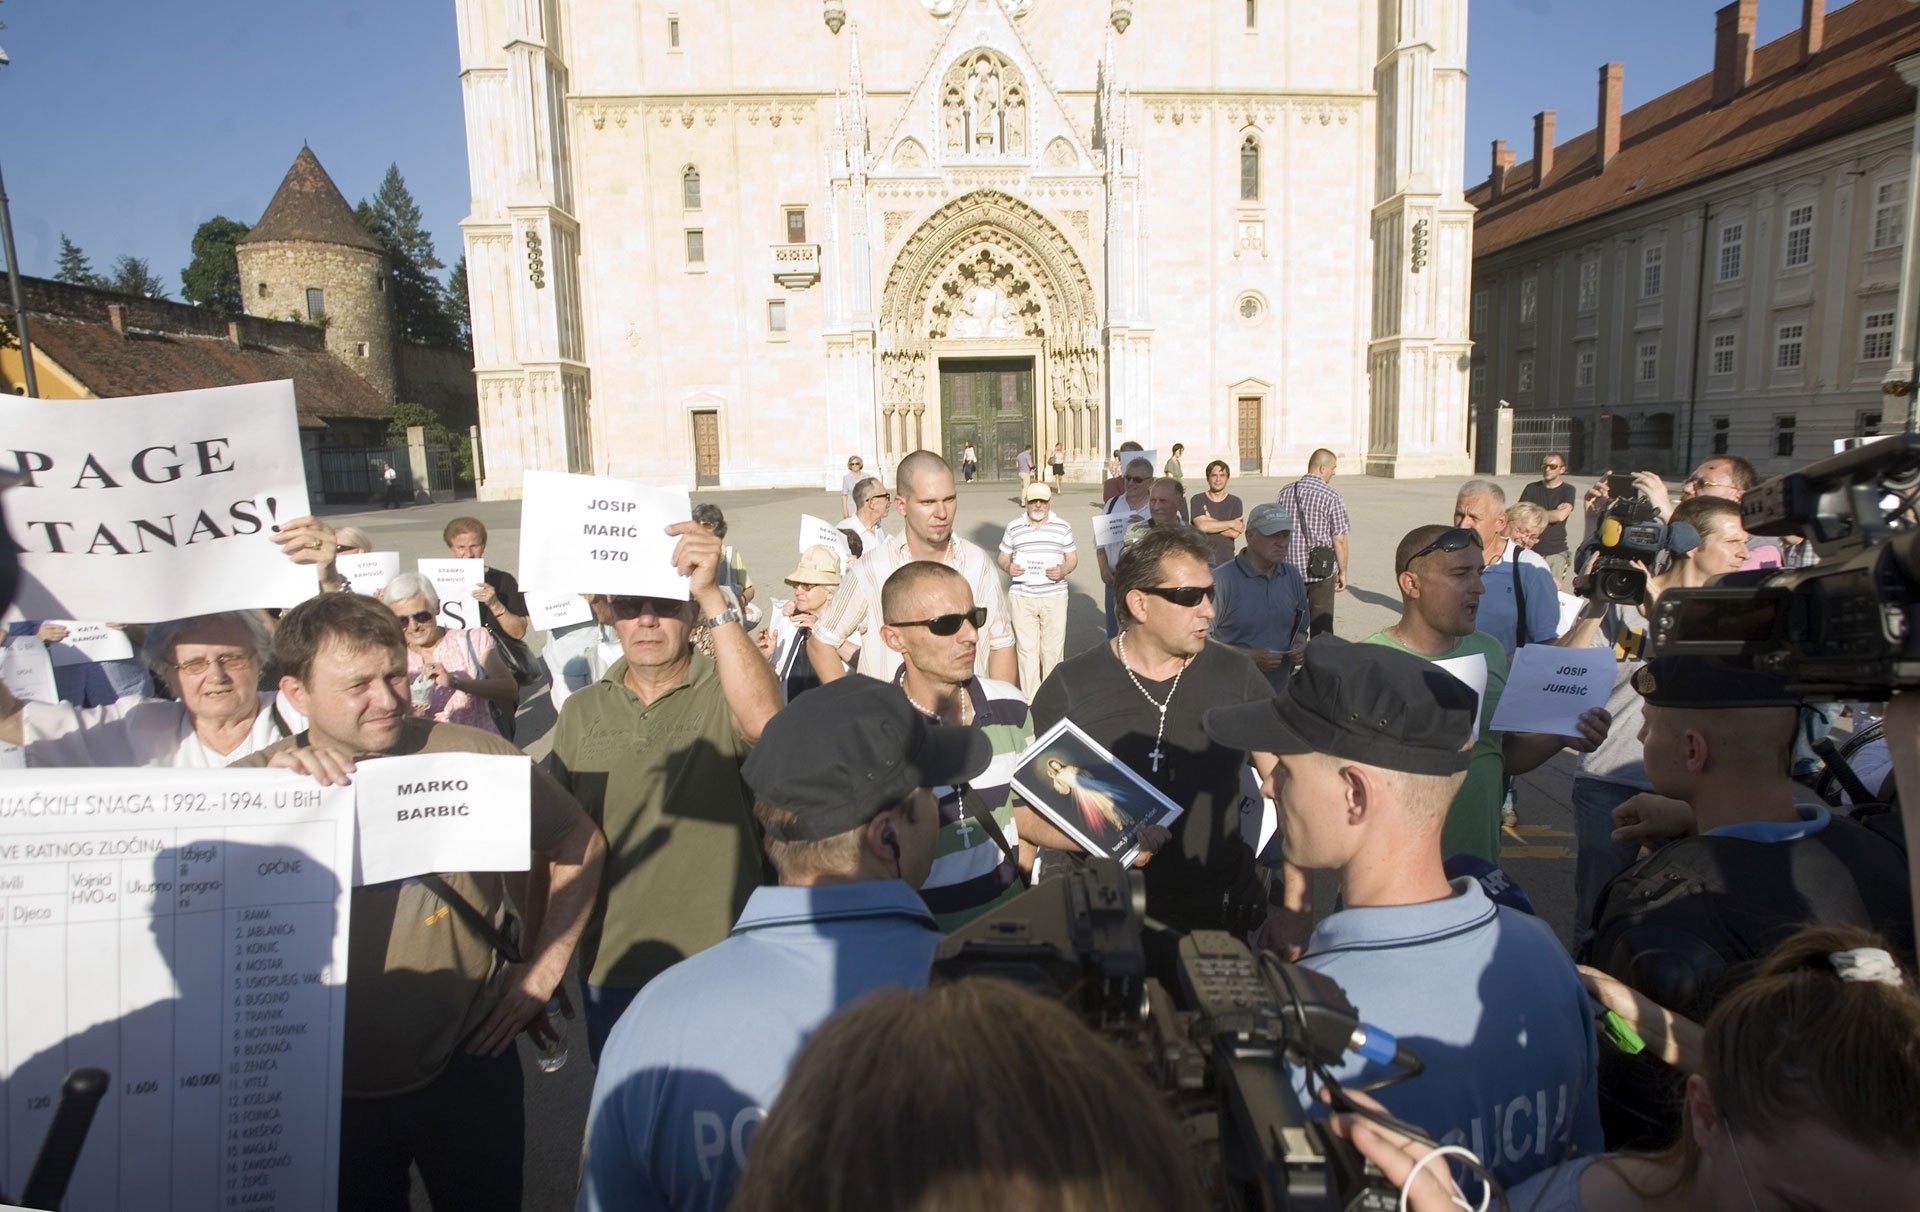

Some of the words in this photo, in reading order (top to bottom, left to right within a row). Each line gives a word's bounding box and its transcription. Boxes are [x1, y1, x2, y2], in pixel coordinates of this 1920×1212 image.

[587, 499, 637, 513] JOSIP
[17, 497, 280, 555] TANAS!
[584, 523, 638, 538] MARIĆ
[590, 549, 629, 562] 1970
[77, 625, 100, 633] KATA
[1556, 666, 1587, 676] JOSIP
[1542, 683, 1587, 696] JURIŠIĆ
[397, 780, 468, 796] MARKO
[84, 793, 155, 815] SNAGA
[274, 791, 287, 809] U
[293, 789, 322, 808] BiH
[397, 803, 469, 821] BARBIĆ
[25, 841, 94, 859] RATNOG
[0, 876, 24, 891] ivili
[127, 879, 173, 895] Ukupno
